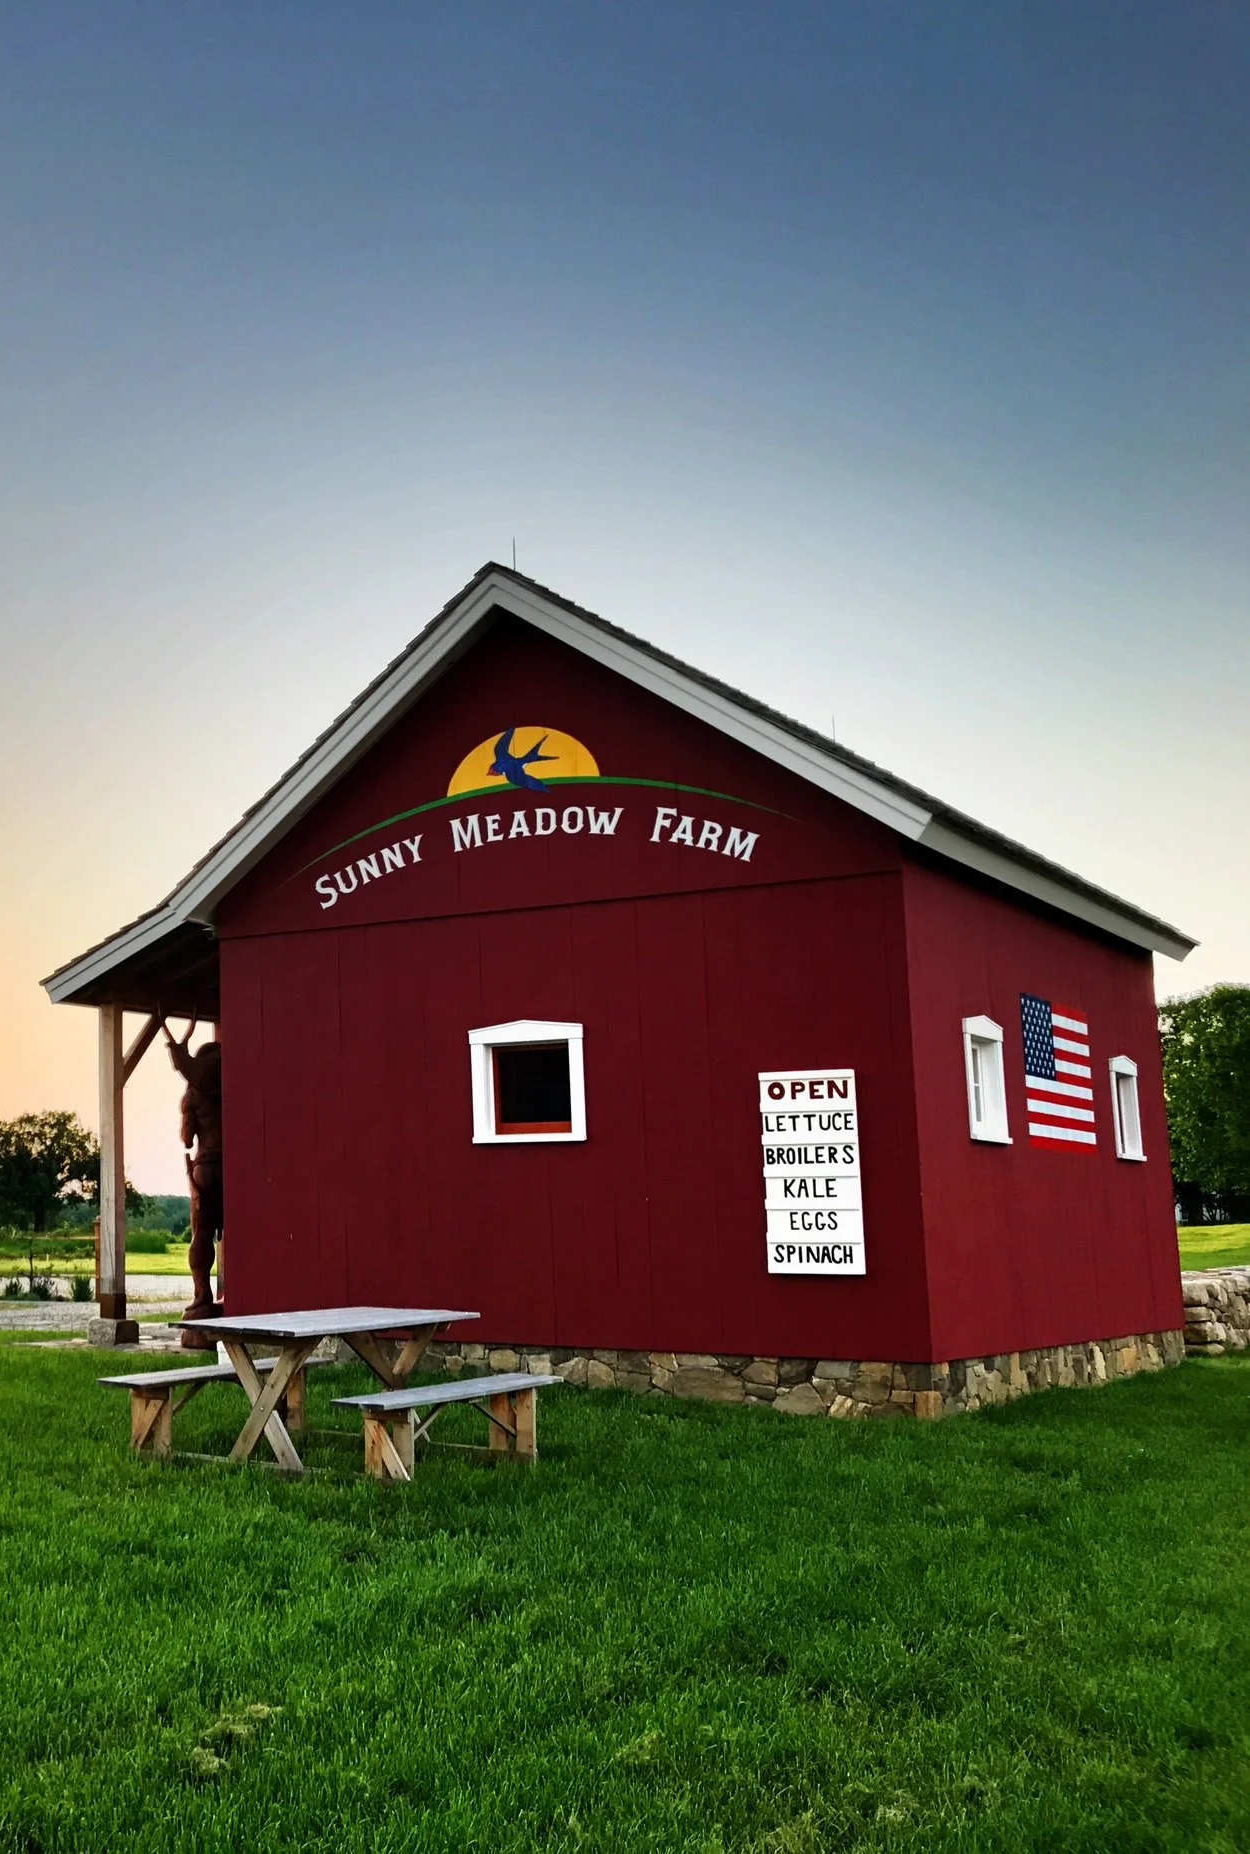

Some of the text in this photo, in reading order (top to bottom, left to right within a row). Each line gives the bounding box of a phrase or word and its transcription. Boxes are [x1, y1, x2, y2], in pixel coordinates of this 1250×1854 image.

[314, 806, 761, 911] SUNNY MEADOW FARM
[767, 1079, 848, 1100] OPEN
[764, 1112, 855, 1132] LETTUCE
[765, 1145, 855, 1165] BROILERS
[783, 1178, 838, 1198] KALE
[789, 1211, 838, 1231] EGGS
[773, 1244, 854, 1264] SPINACH
